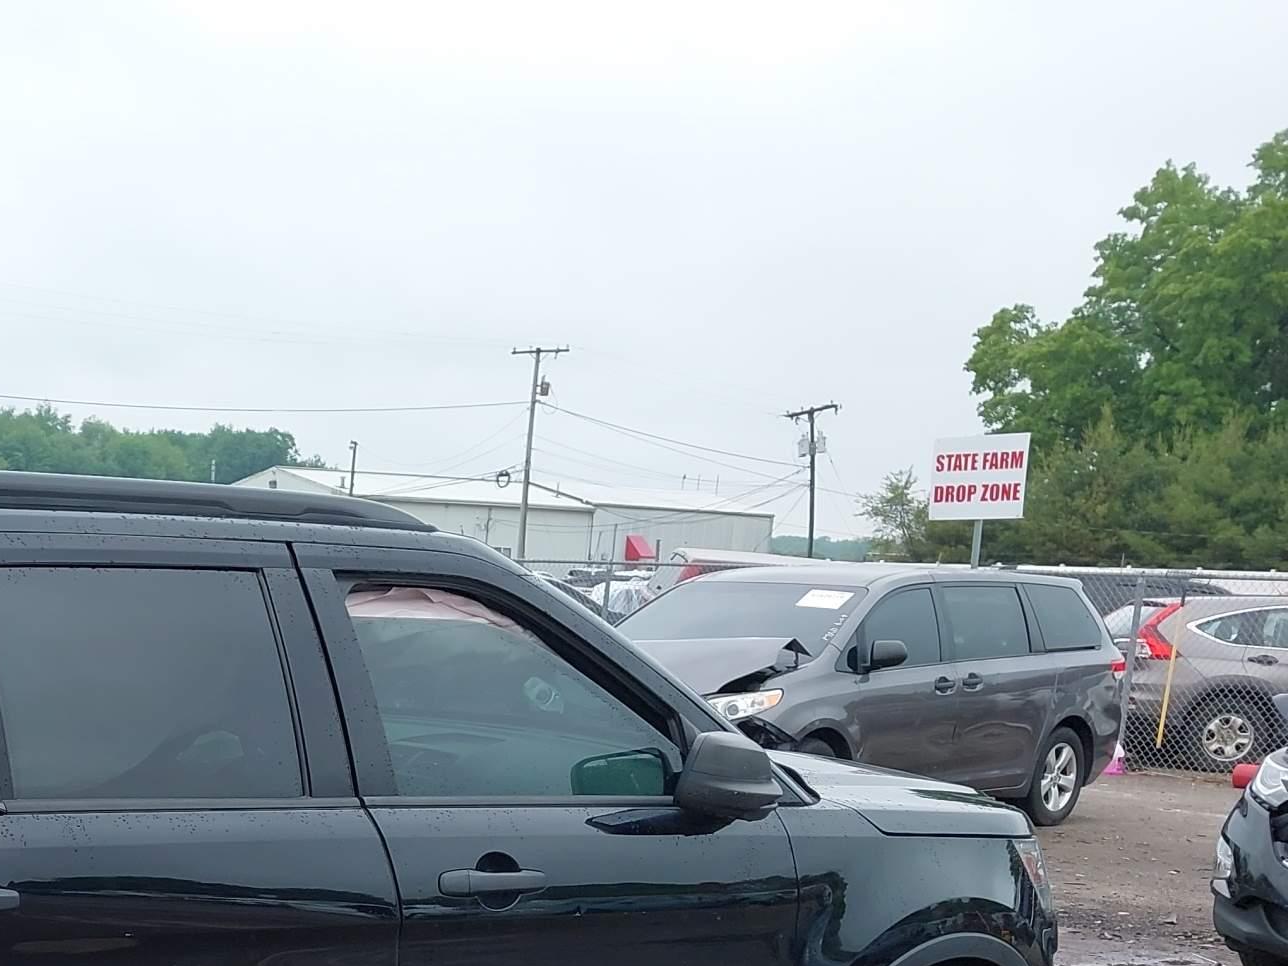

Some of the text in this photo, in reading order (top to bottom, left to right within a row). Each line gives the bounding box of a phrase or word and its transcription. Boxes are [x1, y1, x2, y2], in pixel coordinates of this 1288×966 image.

[936, 450, 1024, 473] STATE FARM
[933, 482, 1021, 503] DROP ZONE
